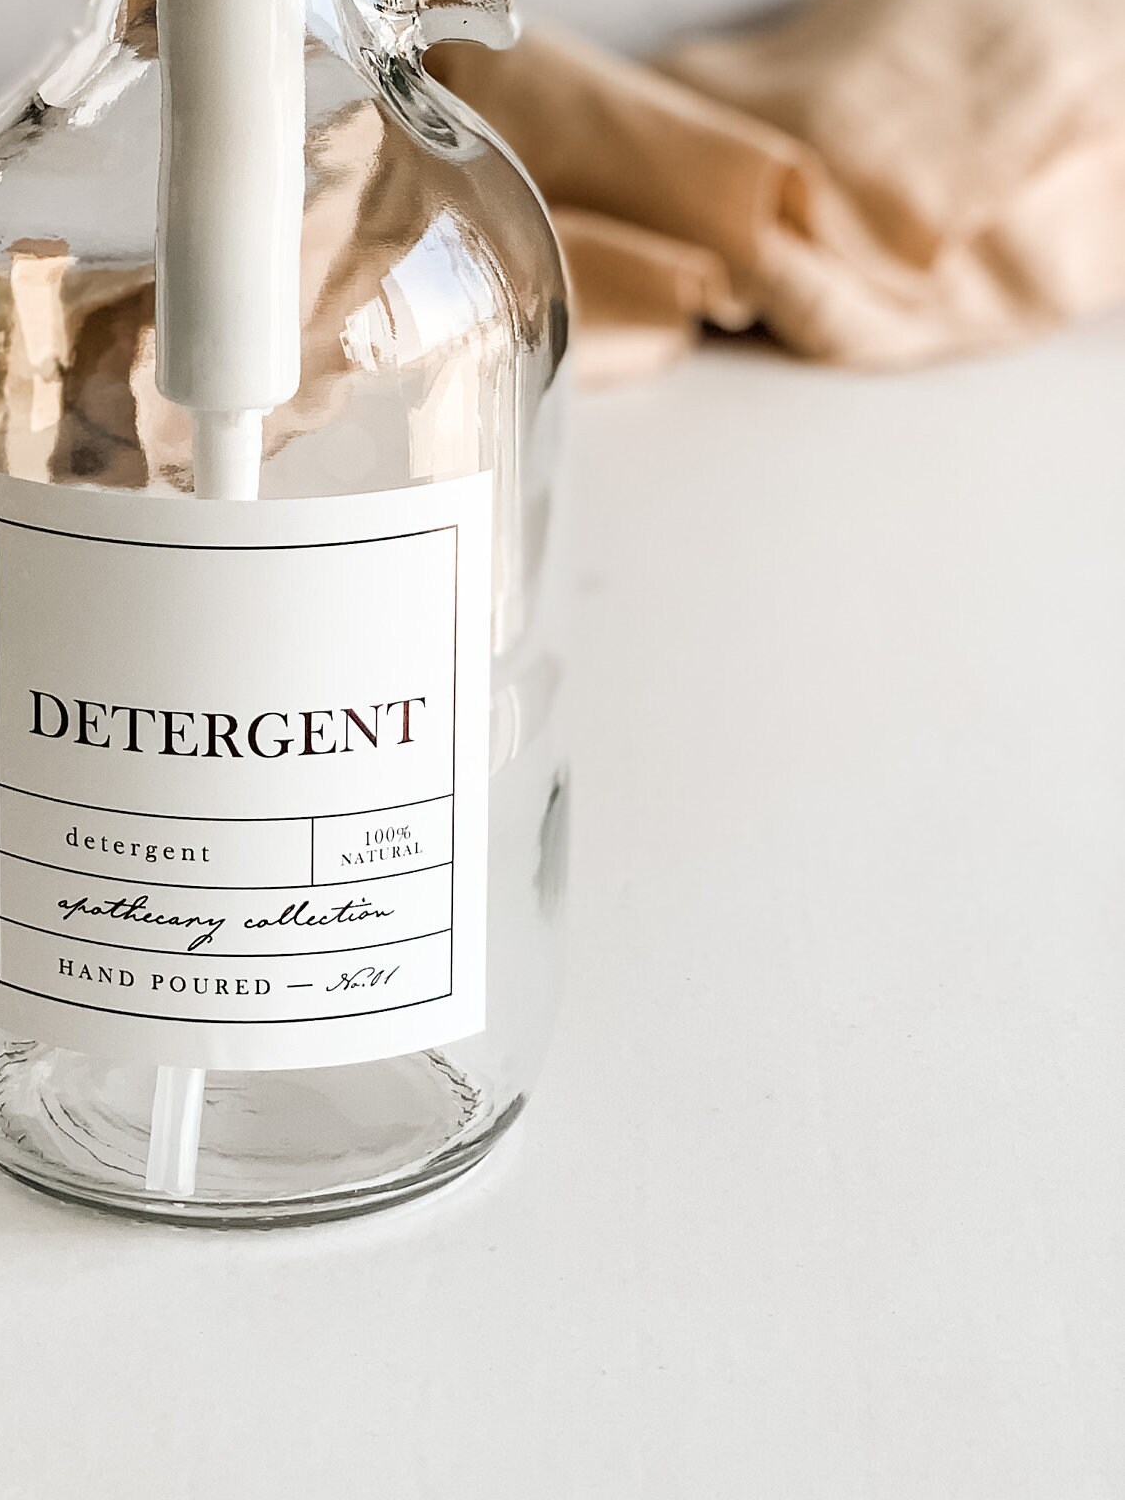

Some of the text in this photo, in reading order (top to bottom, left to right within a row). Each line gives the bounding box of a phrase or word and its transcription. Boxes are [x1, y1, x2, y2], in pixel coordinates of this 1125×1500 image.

[28, 689, 427, 759] DETERGENT
[65, 826, 210, 863] detergent
[340, 841, 423, 867] NATURAL
[365, 824, 412, 847] 100%
[57, 894, 395, 952] apothecary collection
[58, 957, 135, 988] HAND
[150, 973, 271, 996] POURED
